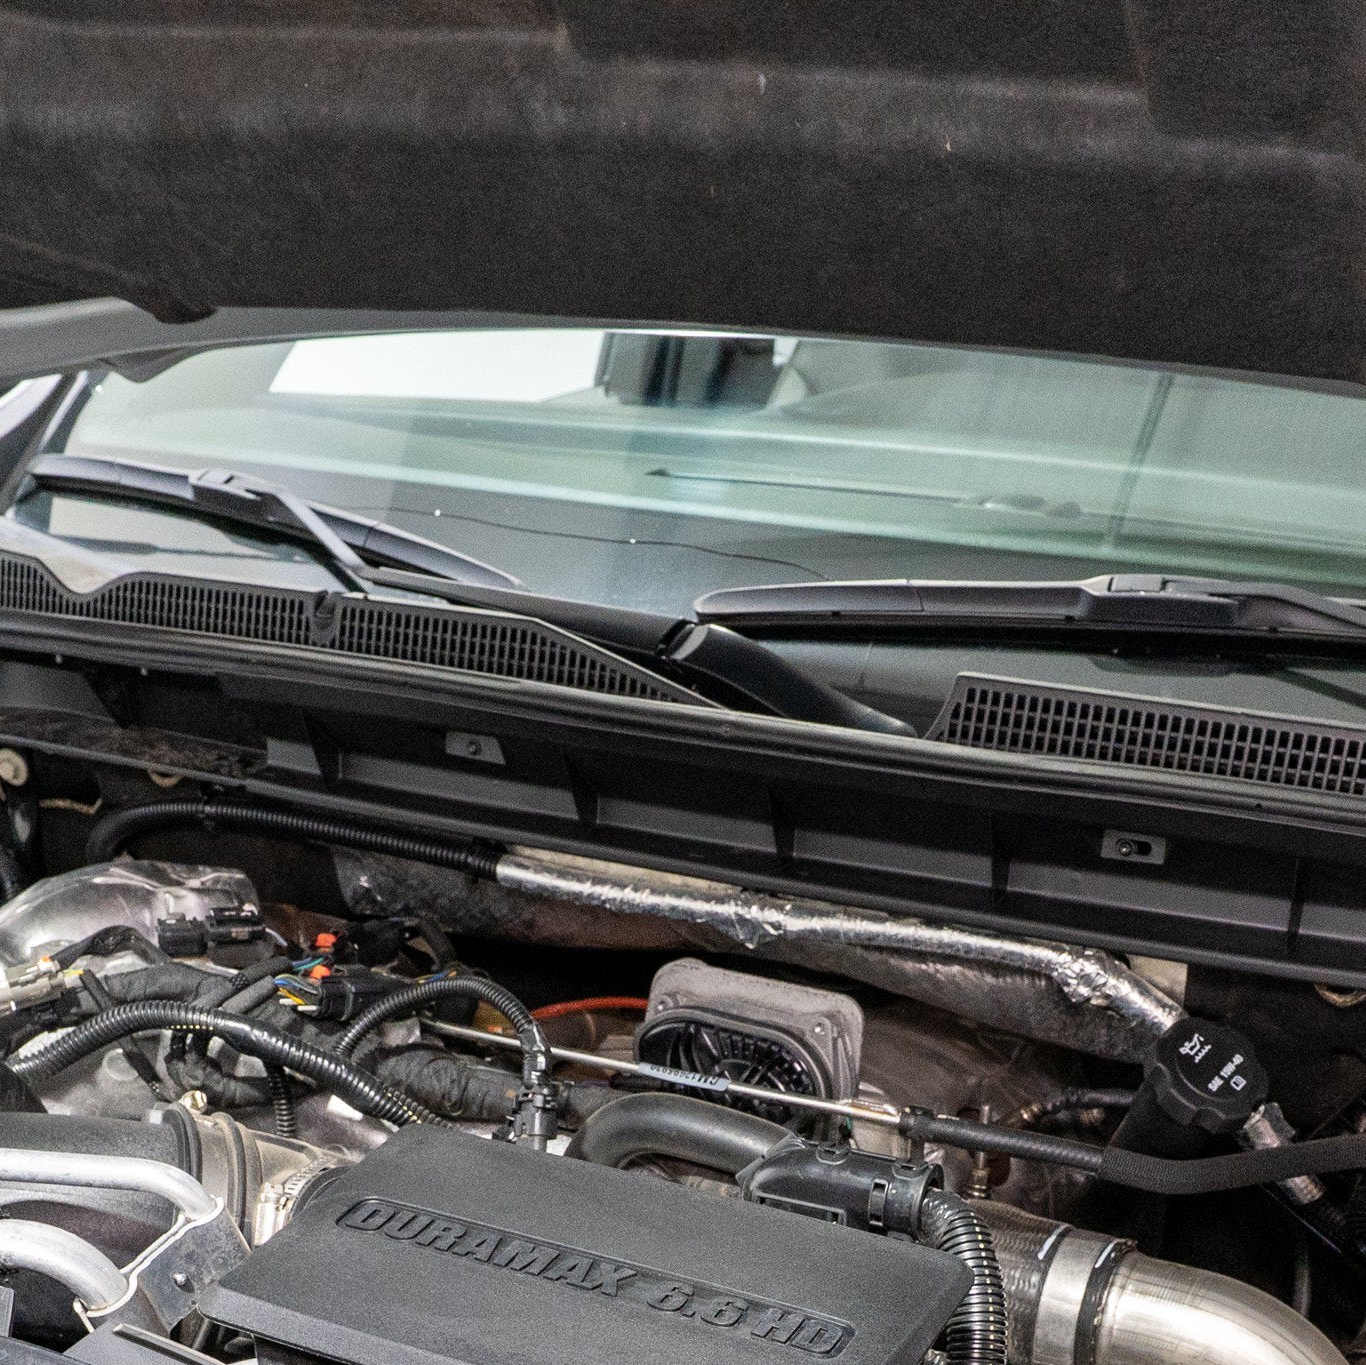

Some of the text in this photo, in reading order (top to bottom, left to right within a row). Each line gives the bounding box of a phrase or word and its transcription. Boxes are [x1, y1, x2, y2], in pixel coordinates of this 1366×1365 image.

[1208, 1076, 1224, 1092] SAE
[342, 1201, 852, 1356] DURAMAX 6.6 HD
